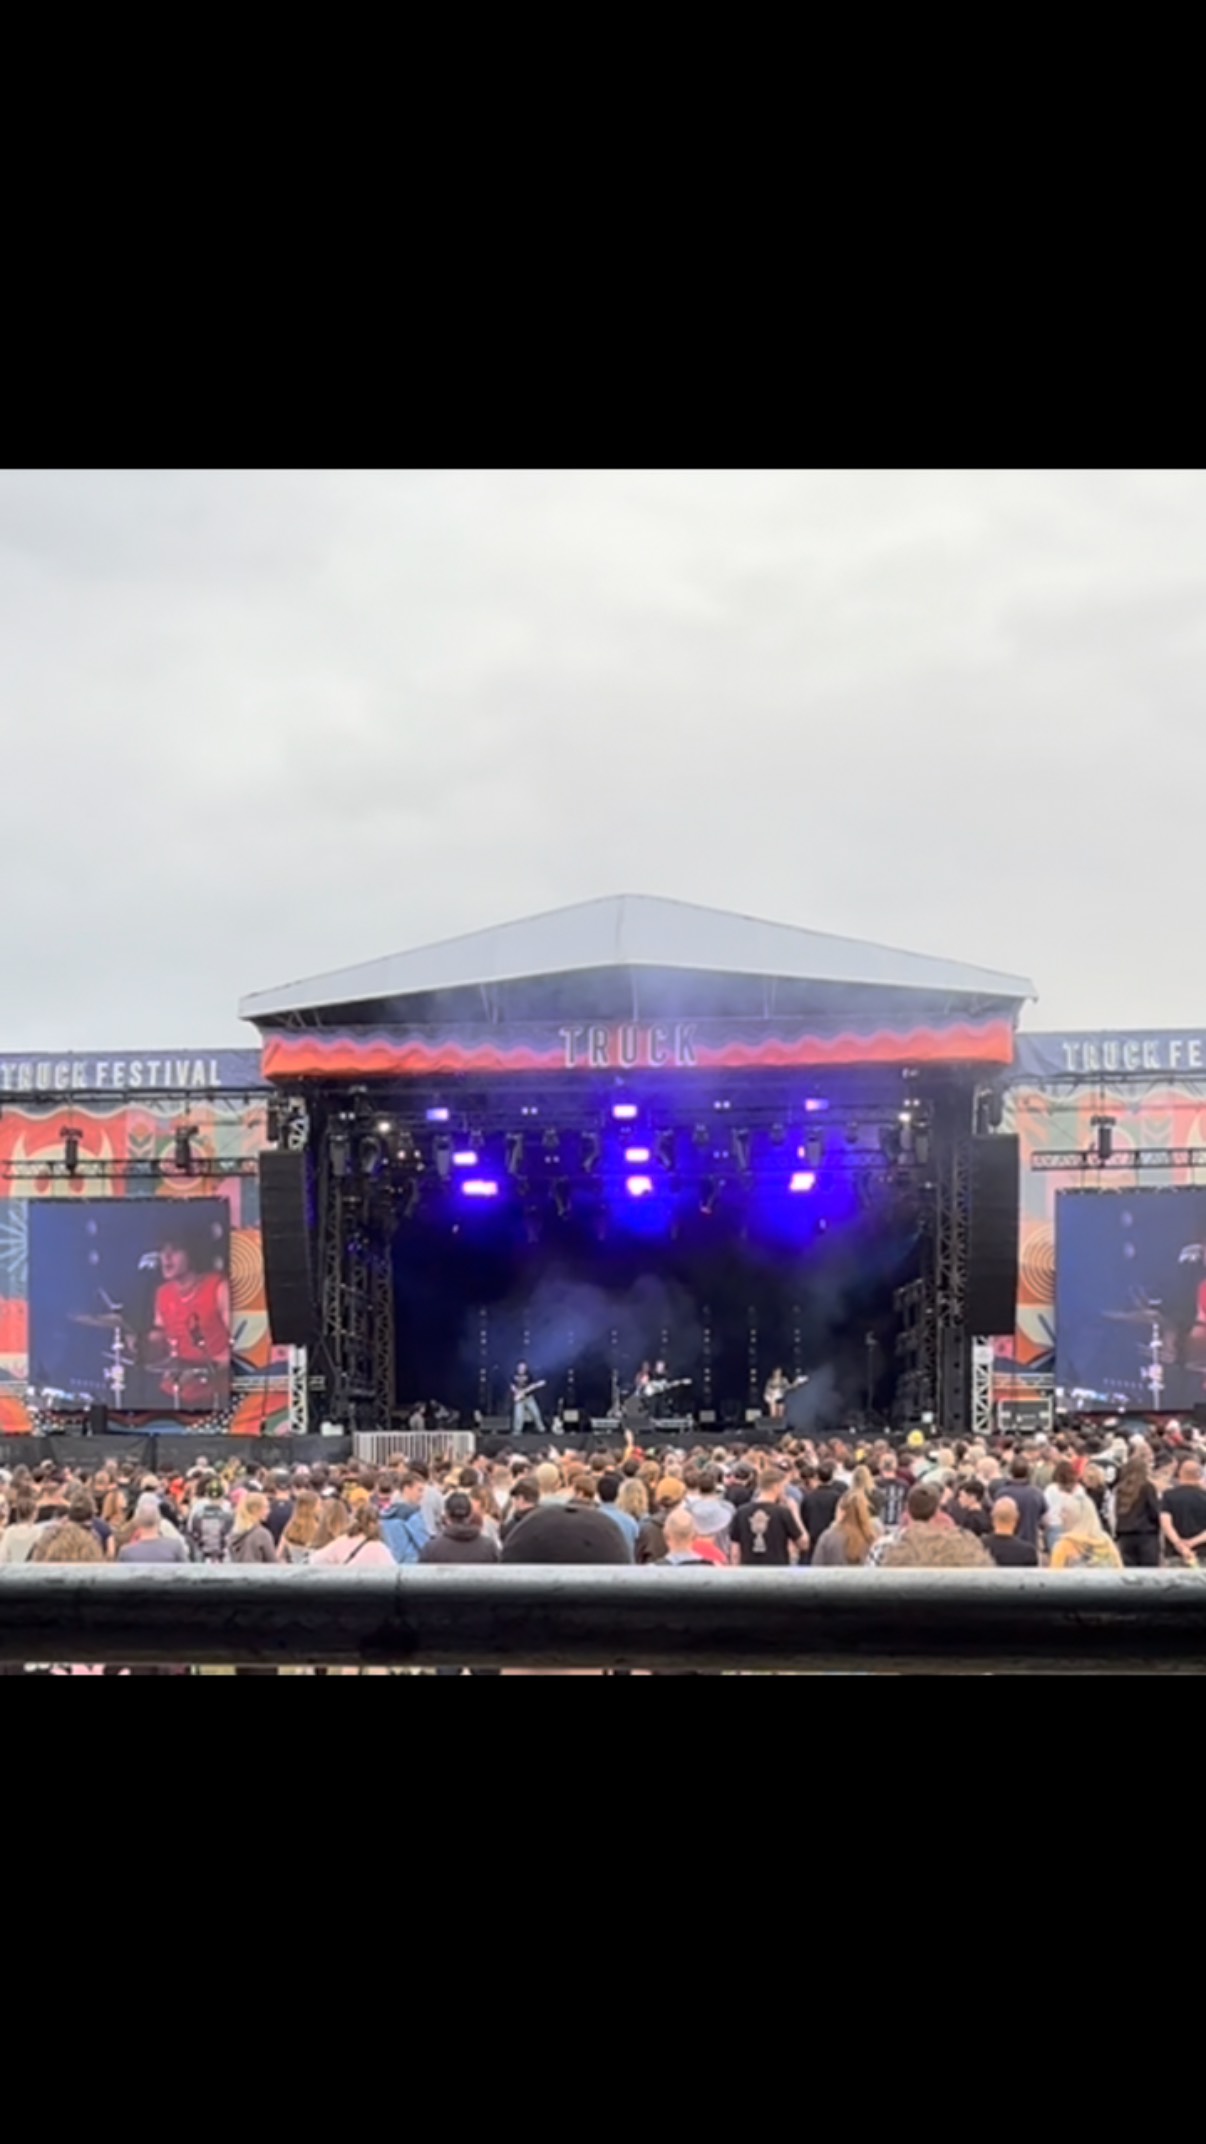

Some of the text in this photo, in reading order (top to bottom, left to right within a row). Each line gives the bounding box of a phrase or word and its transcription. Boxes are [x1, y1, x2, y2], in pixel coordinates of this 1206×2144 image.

[558, 1023, 698, 1068] TRUCK
[1062, 1039, 1203, 1073] TRUCK FE
[1, 1058, 222, 1091] TRUCK FESTIVAL
